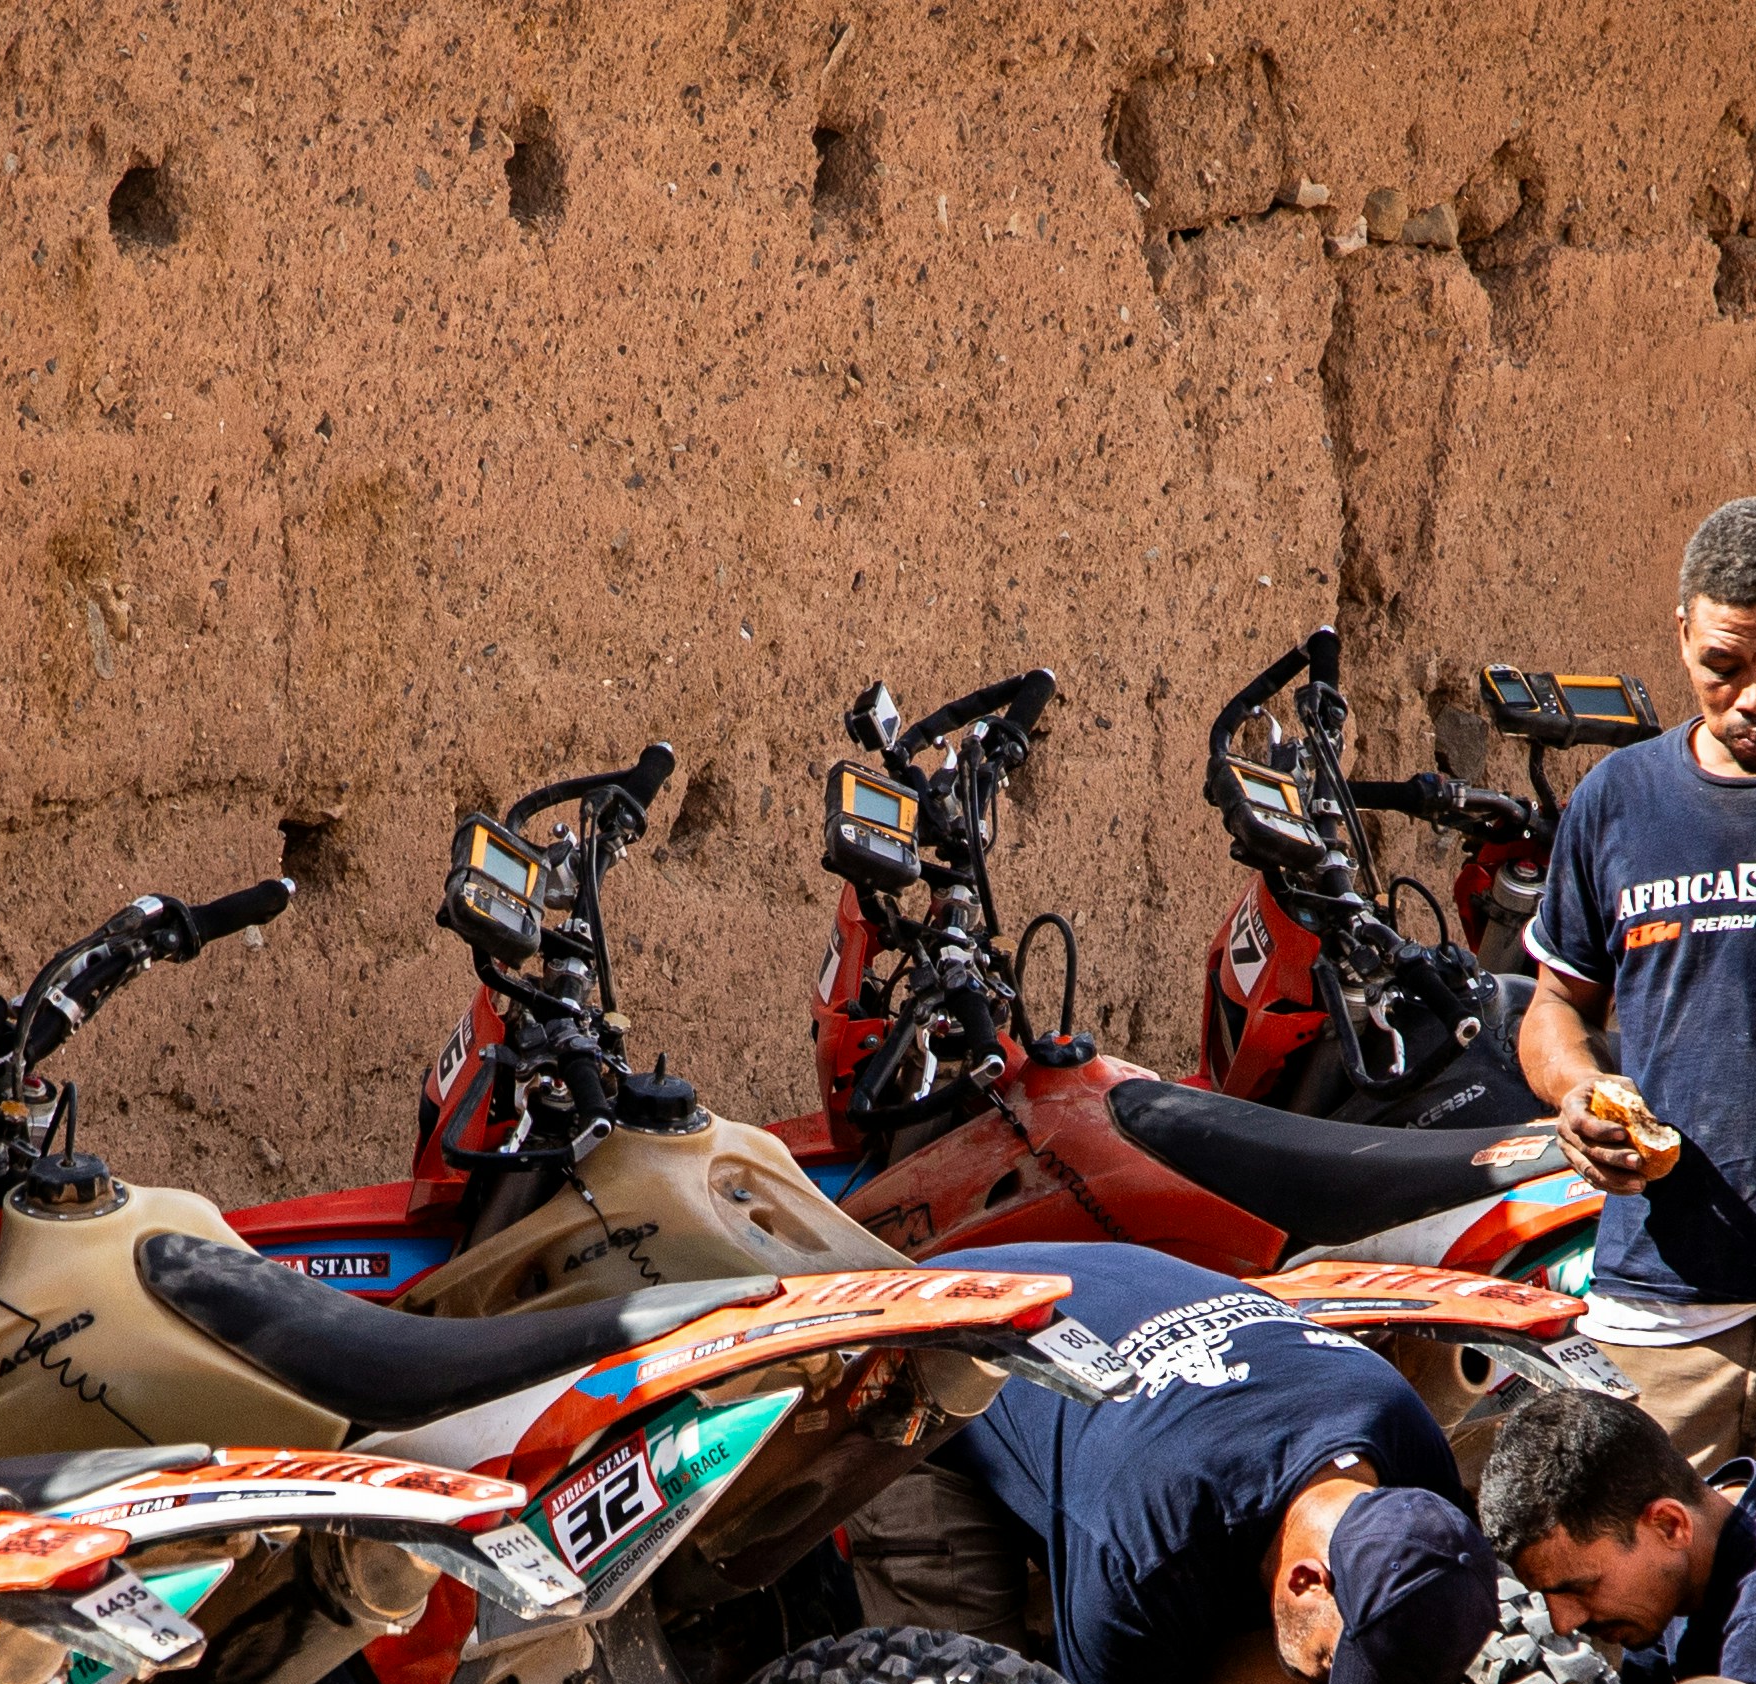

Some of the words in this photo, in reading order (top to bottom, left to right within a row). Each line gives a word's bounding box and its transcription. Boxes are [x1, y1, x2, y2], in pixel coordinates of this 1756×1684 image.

[1618, 870, 1739, 921] AFRICA
[1624, 920, 1682, 951] KTM
[310, 1256, 371, 1277] STAR
[694, 1336, 735, 1359] STAR
[1059, 1328, 1092, 1350] 80
[1558, 1341, 1599, 1364] 4533
[1081, 1351, 1128, 1382] 6425
[550, 1476, 596, 1516] AFRICA
[595, 1446, 632, 1481] STAR
[662, 1476, 684, 1500] TO
[690, 1442, 731, 1480] RACE
[130, 1496, 176, 1517] STAR
[567, 1461, 645, 1566] 32
[487, 1534, 538, 1559] 26111
[585, 1503, 691, 1611] marruecosenmoto.es
[95, 1585, 149, 1620] 4435
[150, 1627, 180, 1646] 80
